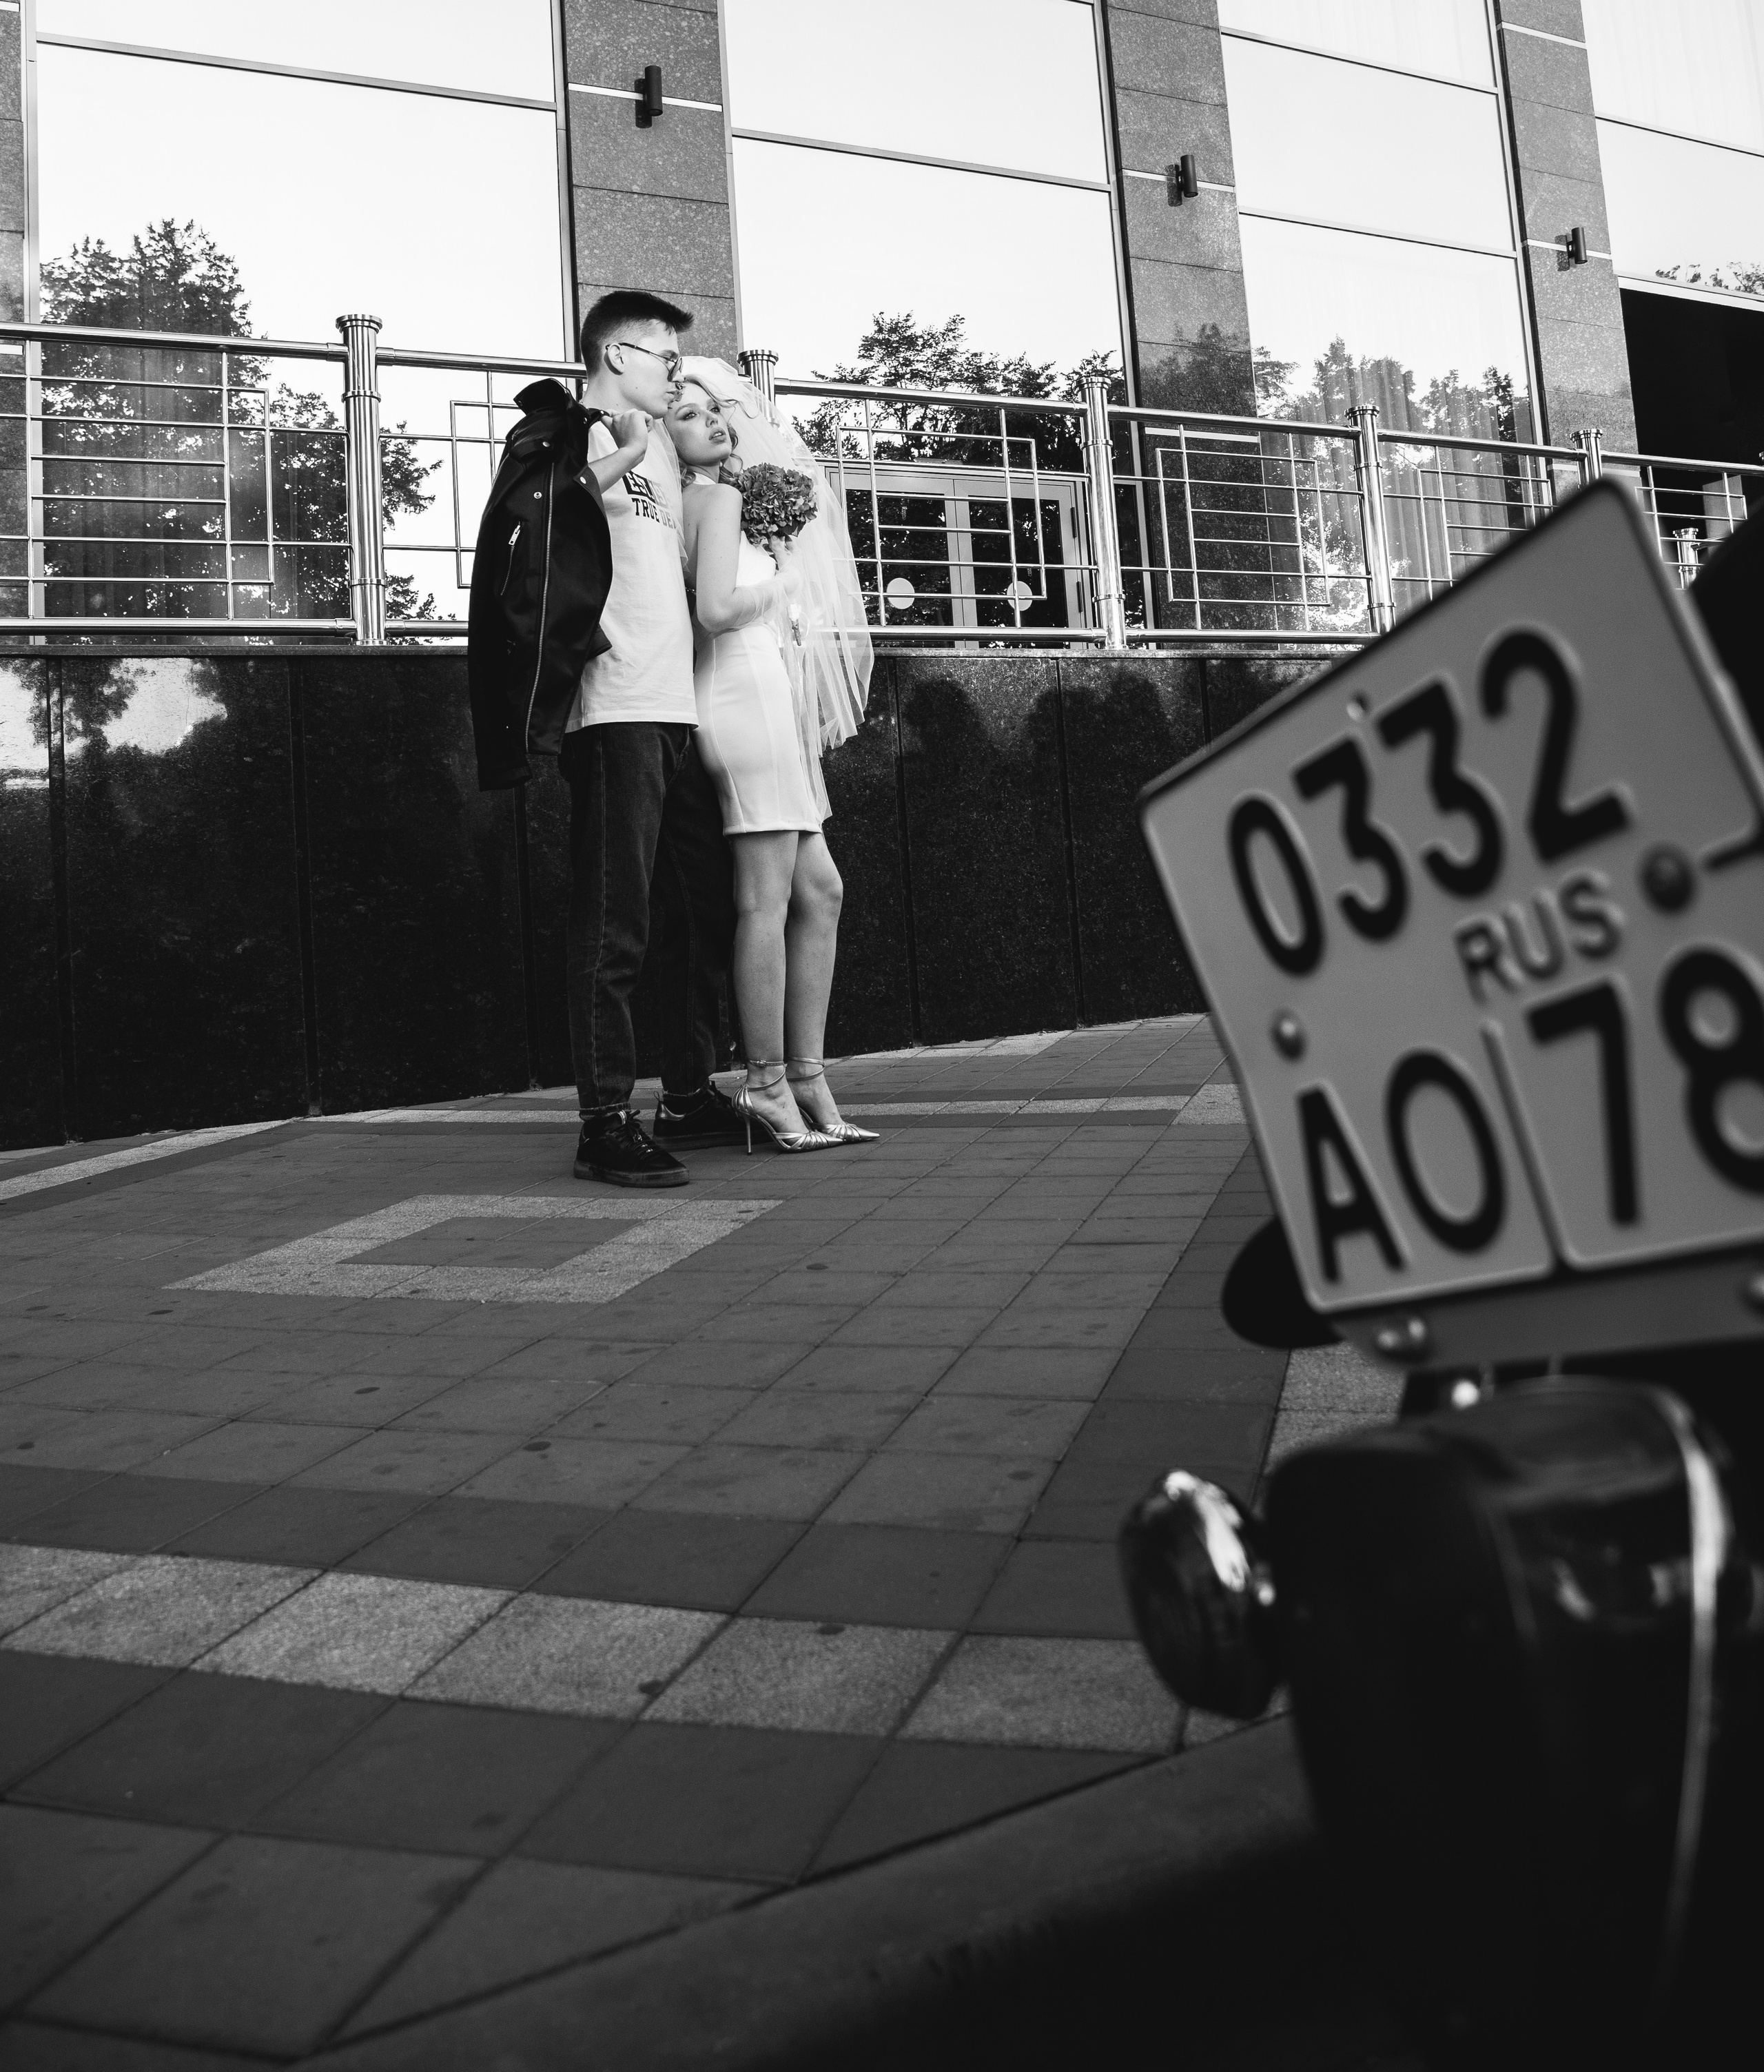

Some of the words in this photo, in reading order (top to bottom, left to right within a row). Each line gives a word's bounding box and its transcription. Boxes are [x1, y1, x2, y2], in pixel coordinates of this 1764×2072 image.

[631, 498, 660, 523] TRUE
[1227, 627, 1633, 977] 0332
[1453, 871, 1623, 1005] RUS
[1295, 1046, 1508, 1285] AO
[1524, 944, 1764, 1228] 78
